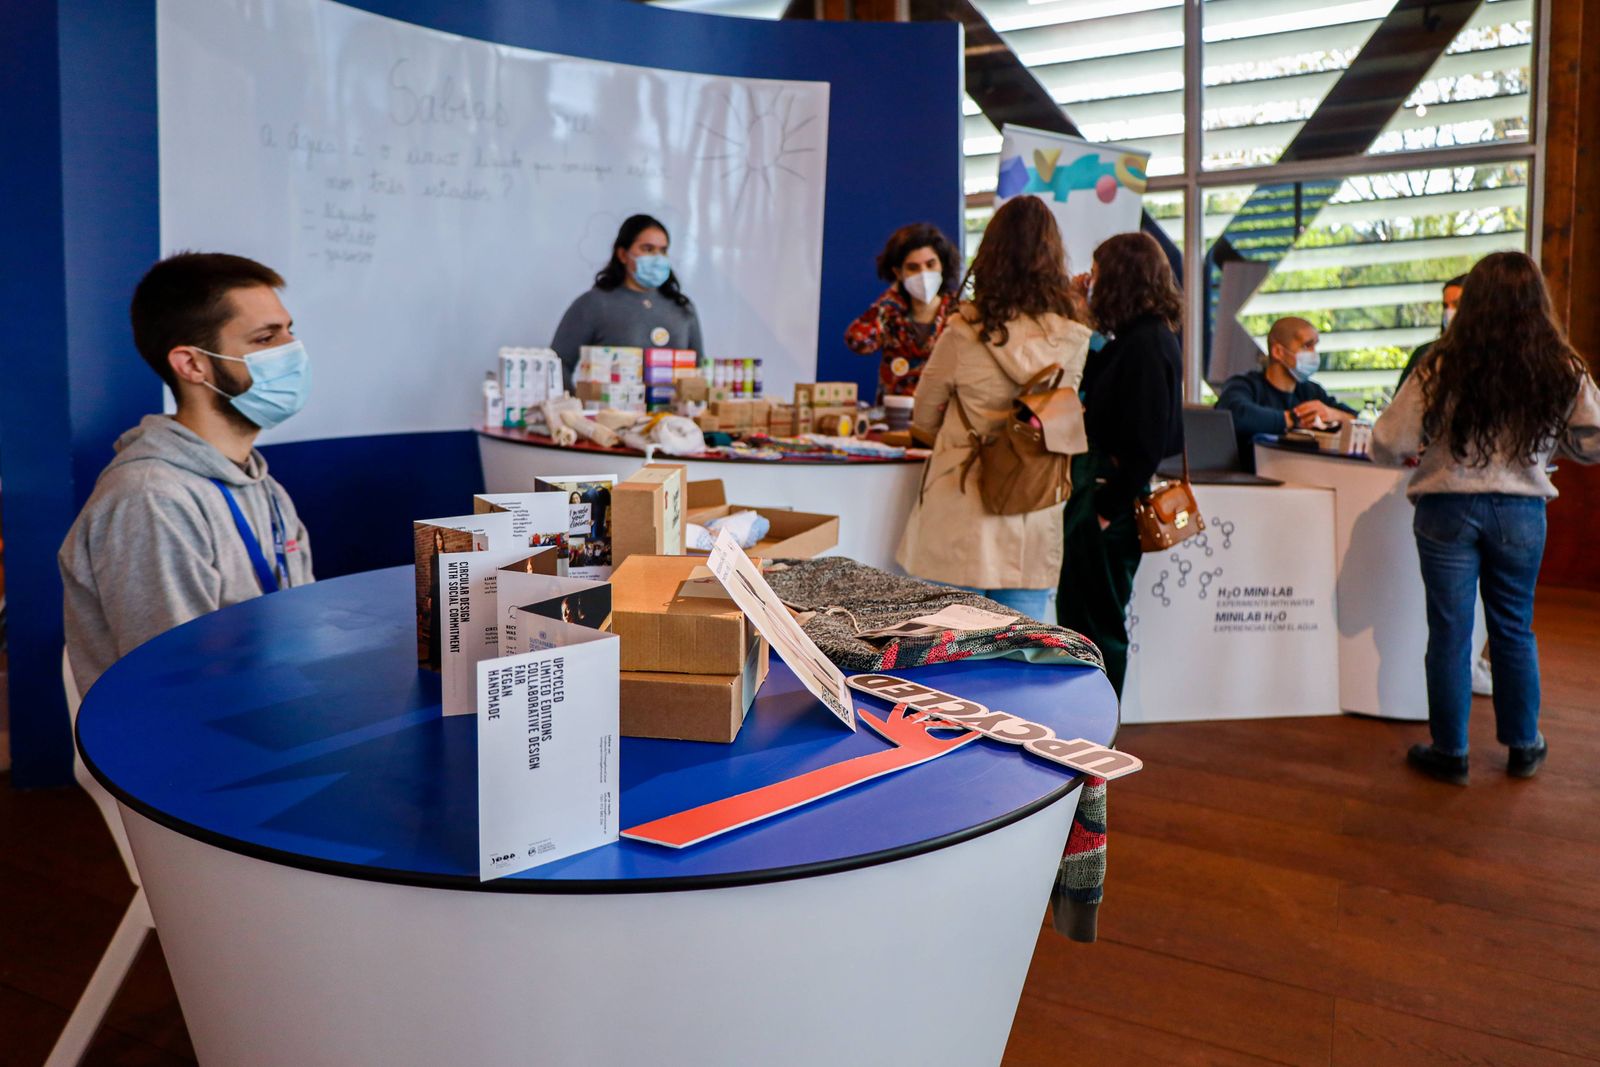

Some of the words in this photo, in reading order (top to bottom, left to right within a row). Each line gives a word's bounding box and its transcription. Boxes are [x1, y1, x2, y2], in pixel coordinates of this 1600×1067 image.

[448, 562, 458, 580] WITH
[459, 561, 469, 596] CIRCULAR
[448, 581, 459, 607] SOCIAL
[460, 597, 470, 623] DESIGN
[449, 608, 460, 653] COMMITMENT
[1215, 611, 1262, 622] MINILAB
[501, 667, 513, 697] VEGAN
[515, 664, 526, 685] FAIR
[540, 660, 551, 696] LIMITED
[552, 657, 564, 703] UPCYCLED
[488, 670, 500, 720] HANDMADE
[527, 662, 540, 735] COLLABORATIVE
[541, 697, 552, 742] EDITIONS
[855, 676, 1135, 775] UPCYCLED
[528, 736, 540, 770] DESIGN
